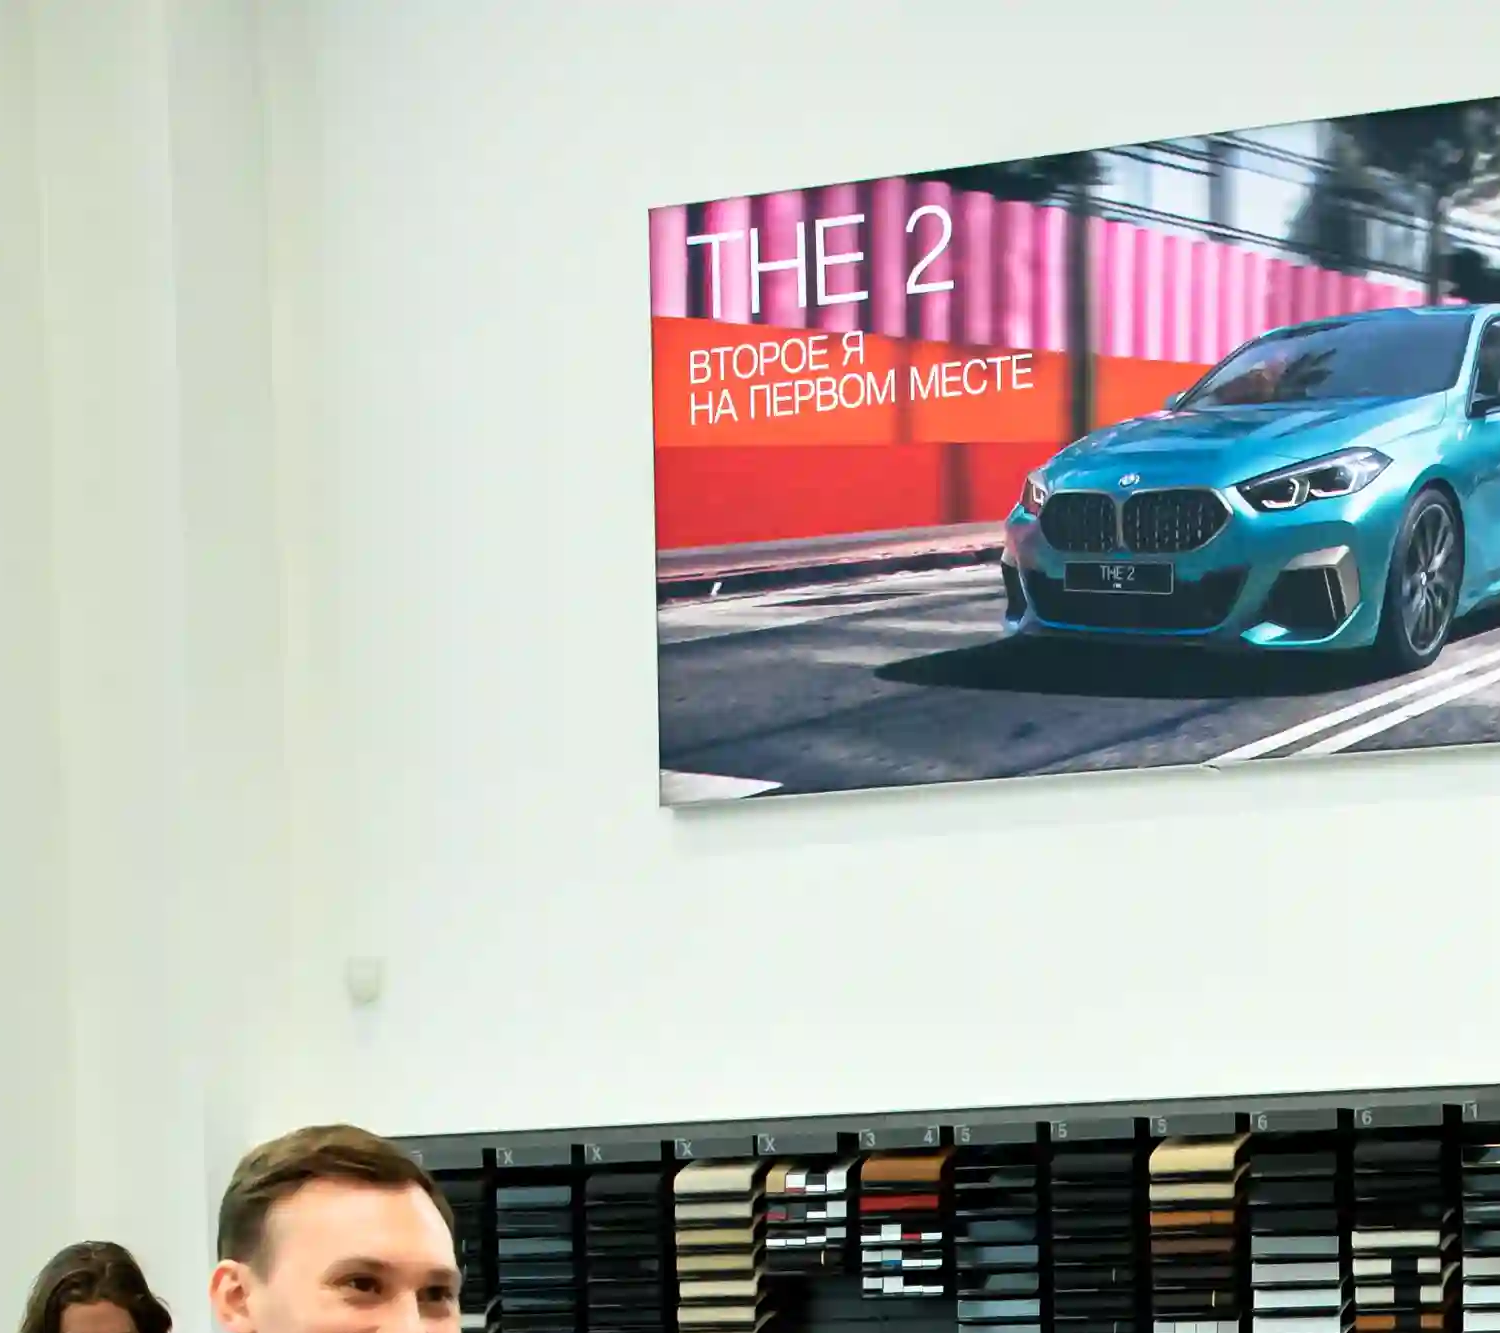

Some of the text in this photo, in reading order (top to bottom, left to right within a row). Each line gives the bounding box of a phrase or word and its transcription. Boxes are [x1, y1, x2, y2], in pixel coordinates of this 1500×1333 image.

[686, 204, 955, 319] THE 2
[689, 330, 865, 385] ВТОРОЕ Я
[690, 352, 1034, 426] НА ПЕРВОМ МЕСТЕ
[1099, 564, 1135, 581] THE 2
[1361, 1110, 1373, 1125] 6
[866, 1129, 933, 1147] 3 4
[961, 1127, 971, 1142] 5
[765, 1137, 776, 1152] X
